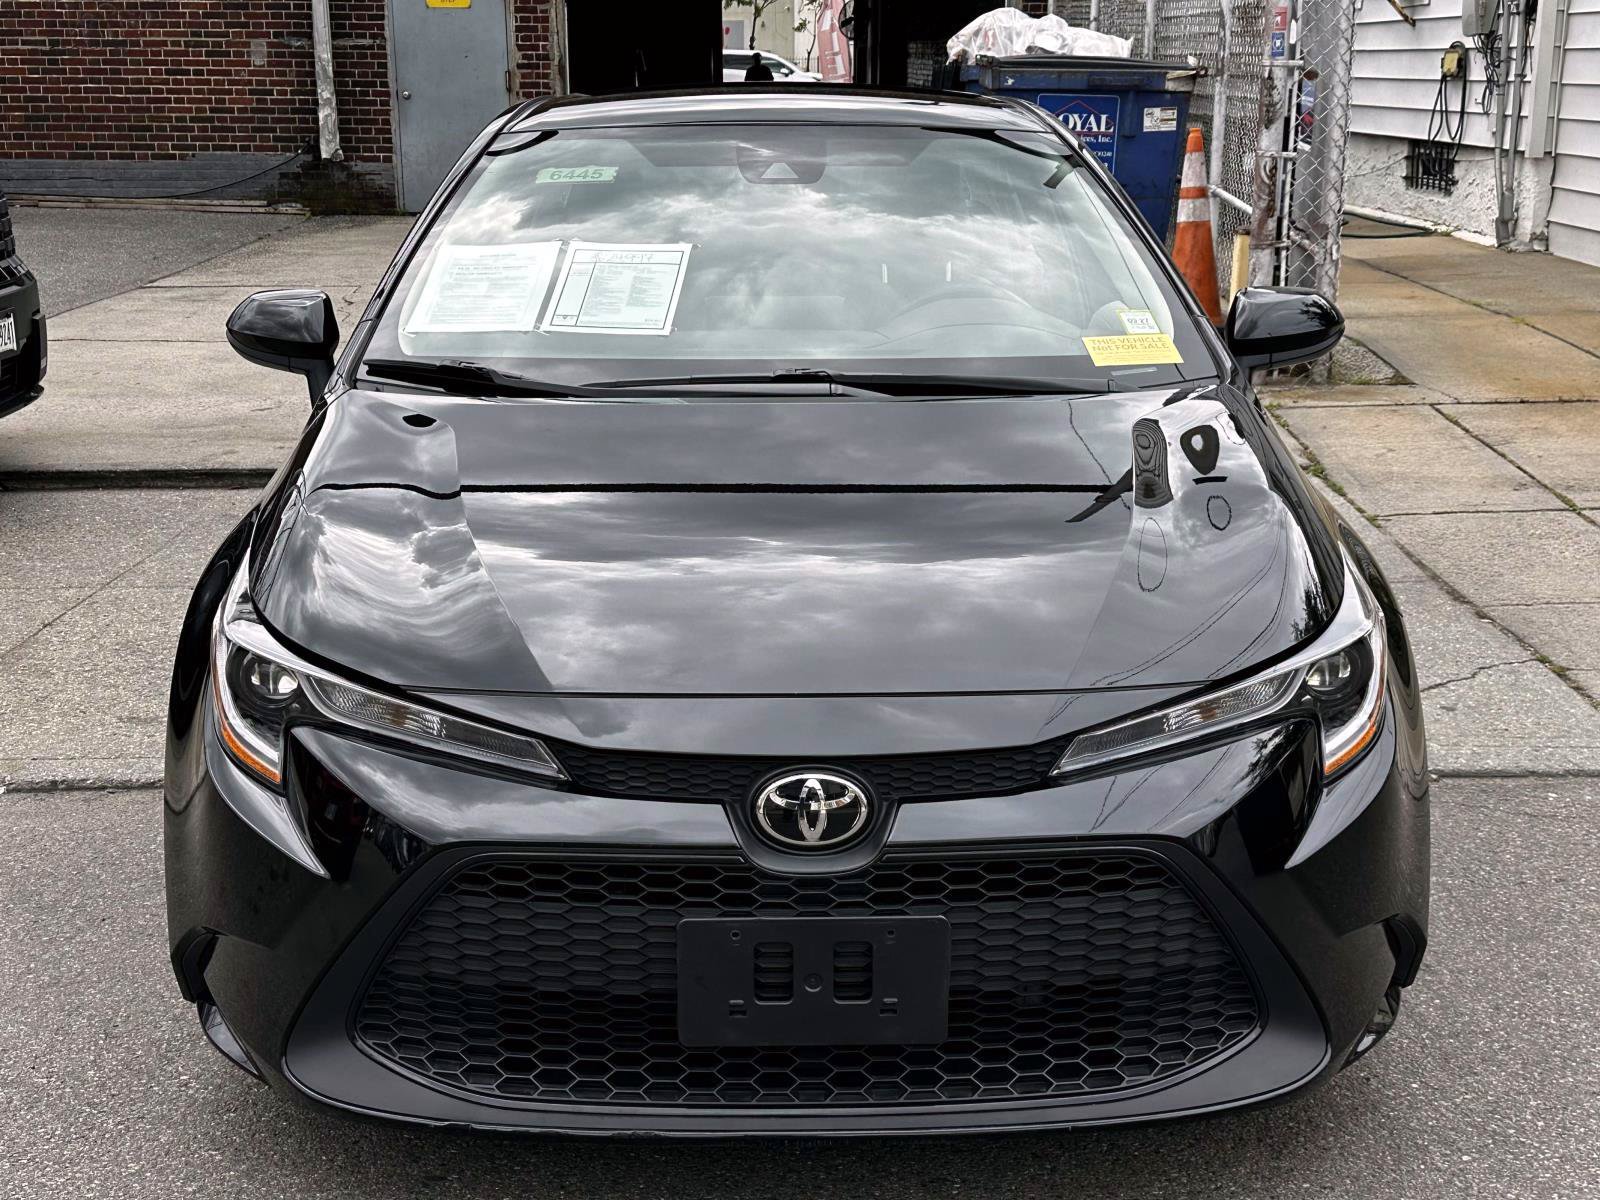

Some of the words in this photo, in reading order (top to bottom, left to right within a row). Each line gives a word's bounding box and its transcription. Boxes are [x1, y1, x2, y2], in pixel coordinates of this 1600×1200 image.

[1058, 112, 1114, 132] OYAL
[549, 168, 605, 181] 6445
[1090, 337, 1116, 345] THIS
[1118, 336, 1166, 344] VEHICLE
